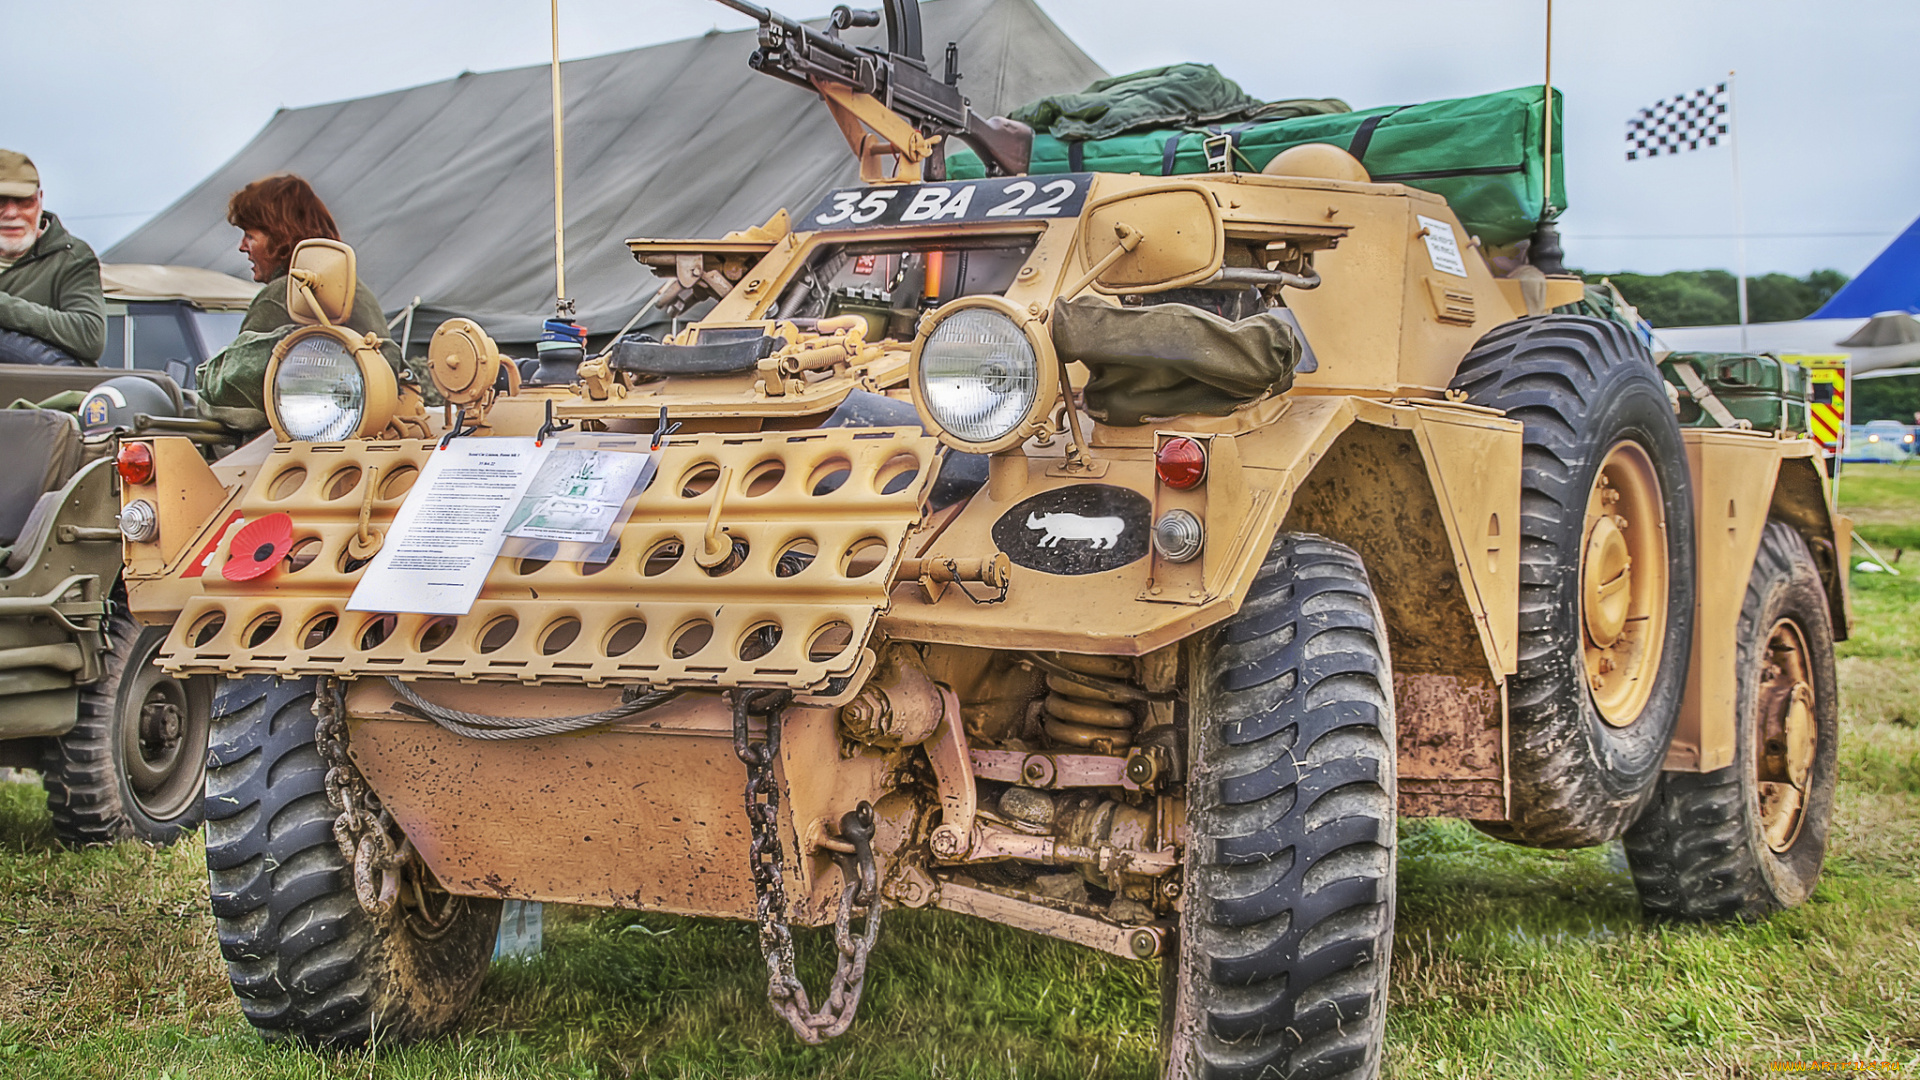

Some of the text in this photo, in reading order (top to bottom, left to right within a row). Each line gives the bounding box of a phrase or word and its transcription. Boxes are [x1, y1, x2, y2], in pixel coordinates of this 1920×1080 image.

[815, 180, 1077, 225] 35 BA 22
